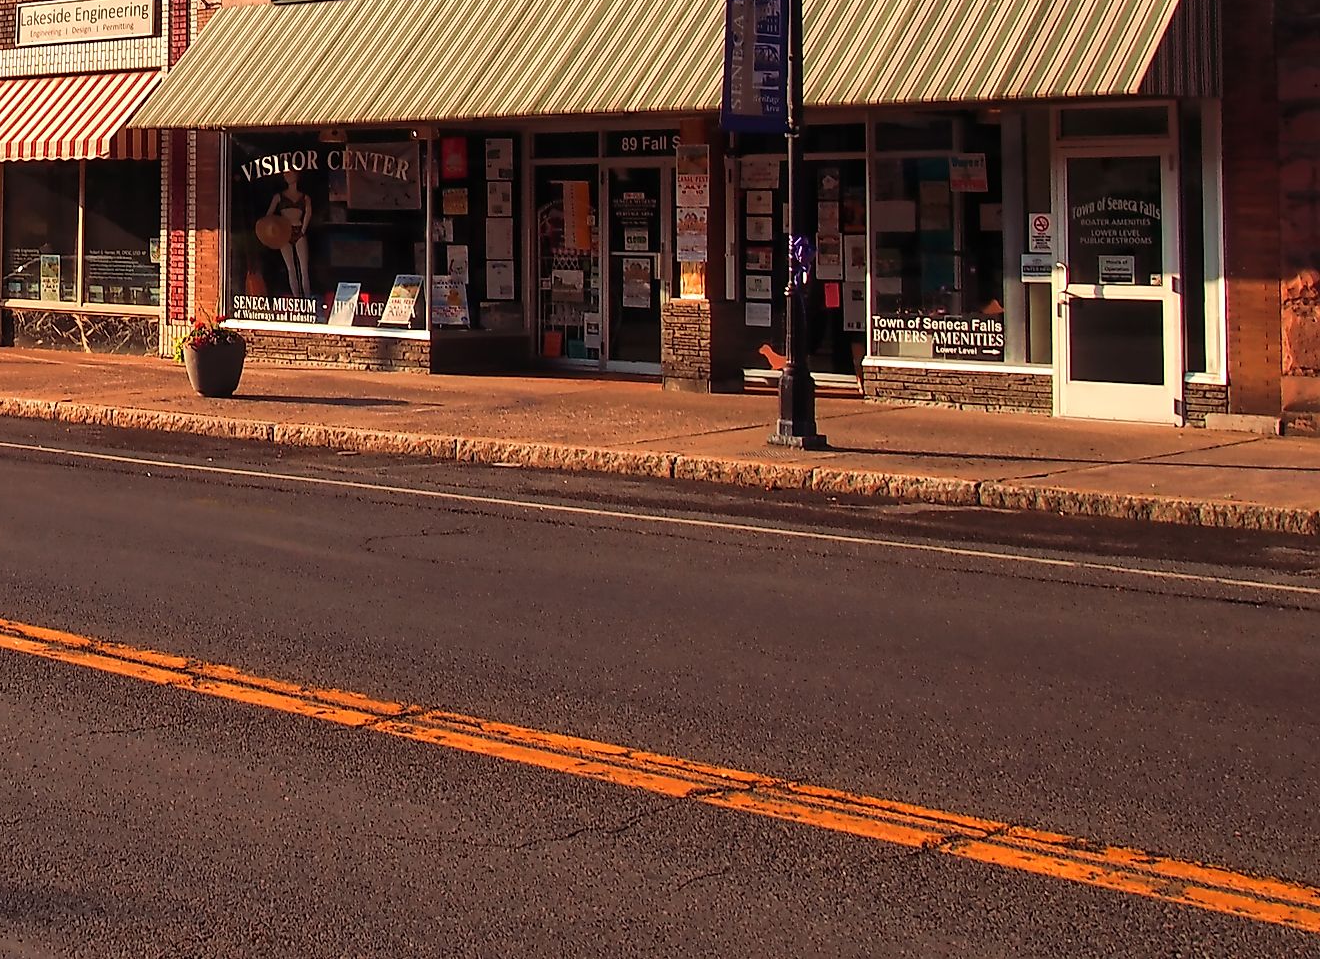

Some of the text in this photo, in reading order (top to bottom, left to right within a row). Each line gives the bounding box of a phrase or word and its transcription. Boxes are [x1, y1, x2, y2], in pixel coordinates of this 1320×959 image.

[21, 2, 149, 27] Lakeside Engineering
[30, 22, 134, 38] Engineering Design Permitting
[732, 15, 745, 110] SENECA
[622, 137, 638, 151] 89
[642, 136, 667, 150] Fall
[241, 150, 410, 183] VISITOR CENTER
[1072, 197, 1160, 220] Town of Seneca Falls
[234, 296, 270, 311] SENECA
[273, 298, 316, 314] MUSEUM
[234, 310, 316, 324] of Waterways and Industry
[872, 315, 1002, 332] Town of Seneca Falls
[872, 328, 1004, 347] BOATERS AMENITIES
[936, 346, 978, 355] Lower Level
